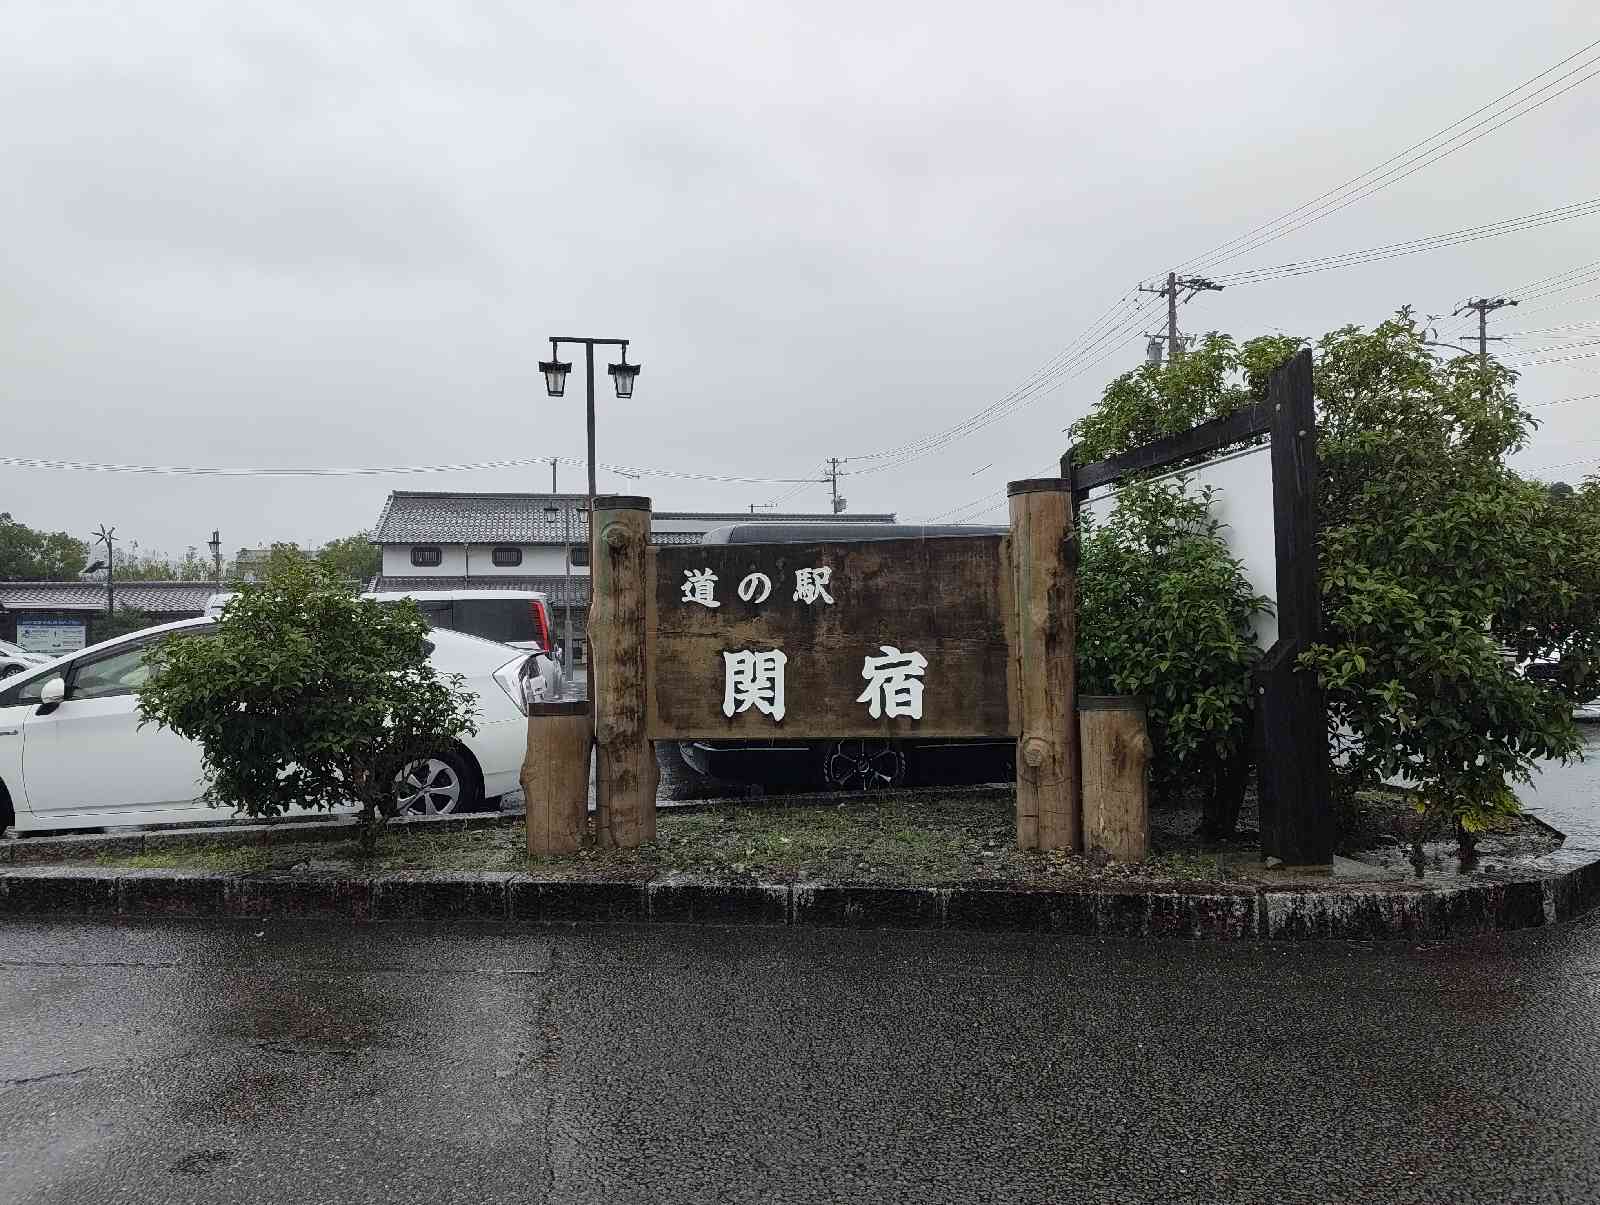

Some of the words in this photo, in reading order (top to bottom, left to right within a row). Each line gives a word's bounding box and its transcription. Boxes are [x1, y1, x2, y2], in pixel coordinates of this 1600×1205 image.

[680, 565, 834, 608] 道の駅
[722, 645, 928, 721] 関宿
